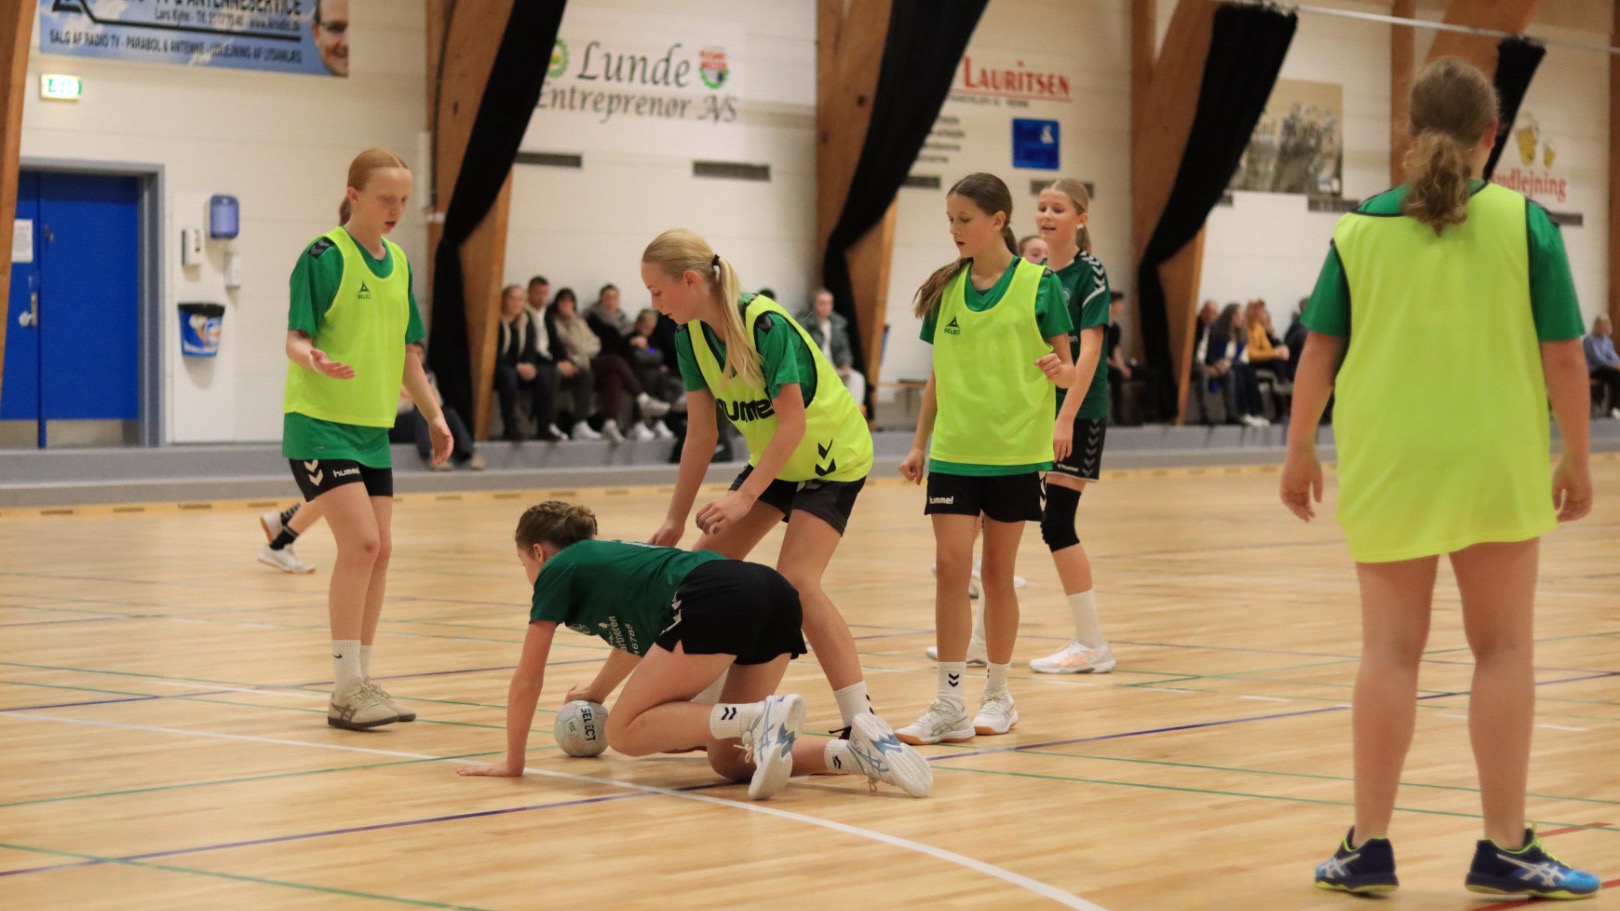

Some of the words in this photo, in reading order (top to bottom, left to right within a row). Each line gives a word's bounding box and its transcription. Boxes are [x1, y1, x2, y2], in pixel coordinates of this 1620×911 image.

[49, 29, 70, 44] SALG
[577, 41, 691, 88] Lunde
[580, 707, 596, 741] SELECT
